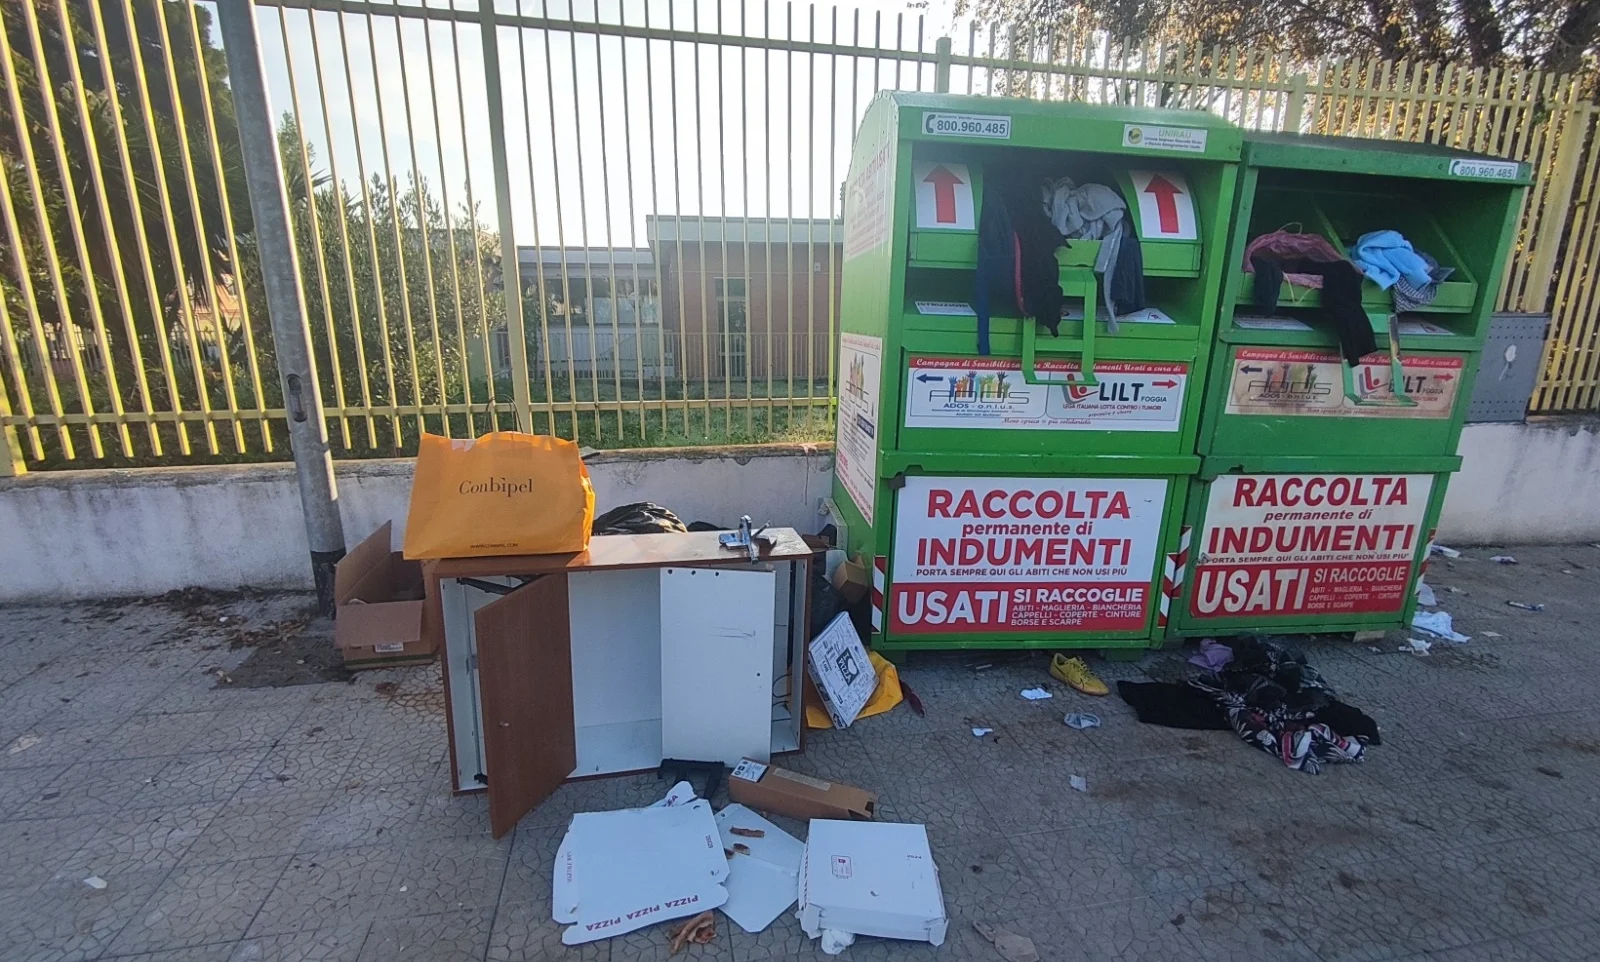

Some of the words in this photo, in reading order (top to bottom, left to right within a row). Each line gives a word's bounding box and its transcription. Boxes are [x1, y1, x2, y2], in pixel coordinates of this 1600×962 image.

[937, 120, 1006, 134] 800.960.485
[1158, 128, 1191, 138] UNIRAU
[1460, 166, 1513, 178] 800.960.485
[1242, 350, 1277, 359] Campagna
[916, 359, 960, 368] Campagna
[1042, 362, 1079, 370] Raccolta
[1100, 382, 1144, 402] LILT
[1232, 478, 1408, 507] RACCOLTA
[927, 490, 1131, 519] RACCOLTA
[1263, 510, 1354, 523] permanente
[1359, 509, 1373, 520] di
[962, 522, 1071, 537] permanente
[1075, 521, 1093, 535] di
[1208, 524, 1414, 554] INDUMENTI
[917, 538, 1132, 566] INDUMENTI
[1112, 567, 1127, 575] PIÙ
[1314, 568, 1328, 583] SI
[1329, 566, 1406, 582] RACCOGLIE
[1014, 589, 1031, 603] SI
[1036, 588, 1143, 602] RACCOGLIE
[1197, 568, 1309, 614] USATI
[898, 590, 1009, 625] USATI
[838, 658, 851, 682] PIZZA
[665, 895, 698, 909] PIZZA
[626, 904, 660, 920] PIZZA
[586, 917, 621, 931] PIZZA
